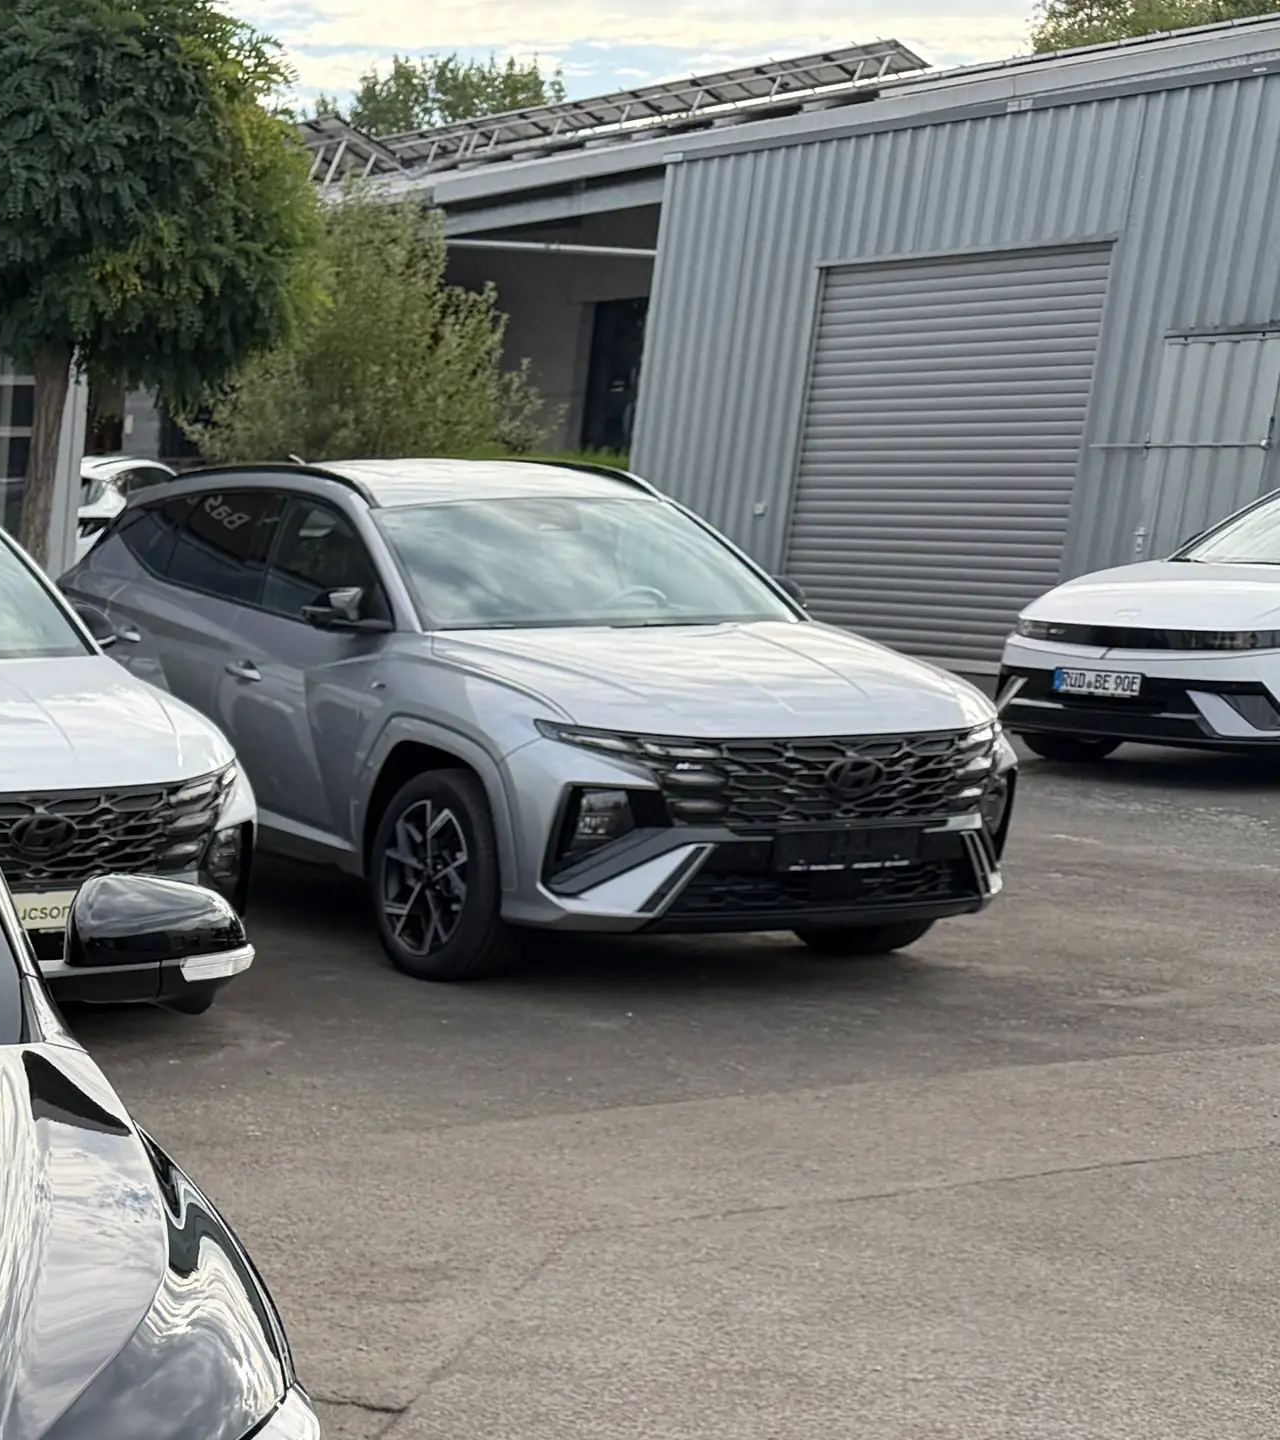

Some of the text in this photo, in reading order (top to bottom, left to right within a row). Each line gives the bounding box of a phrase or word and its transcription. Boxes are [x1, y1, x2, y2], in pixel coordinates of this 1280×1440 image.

[1063, 671, 1139, 693] RÜD BE 90E
